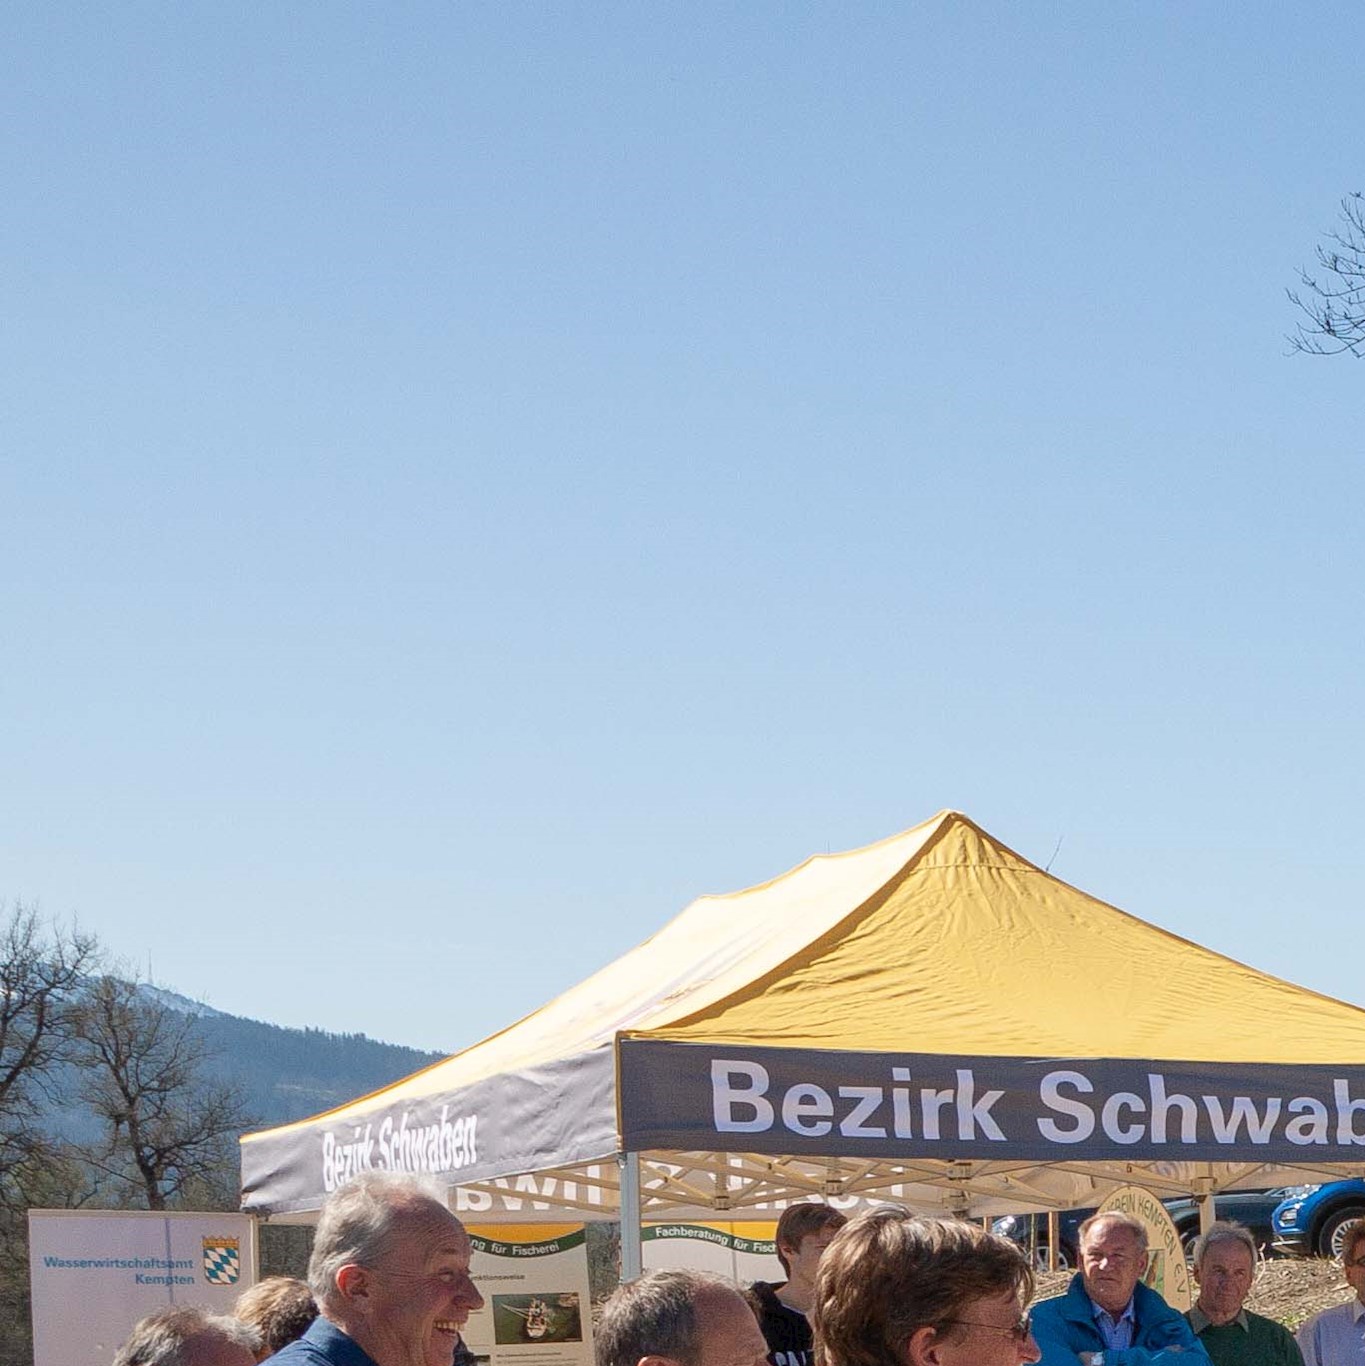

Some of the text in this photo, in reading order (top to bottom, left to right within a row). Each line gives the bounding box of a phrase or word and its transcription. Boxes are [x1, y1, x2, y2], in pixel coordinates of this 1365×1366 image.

[710, 1059, 1007, 1142] Bezirk
[322, 1122, 375, 1192] Bezirk
[378, 1105, 477, 1173] Schwaben
[655, 1227, 729, 1246] Fachberatung
[733, 1238, 749, 1250] für
[490, 1242, 507, 1254] für
[512, 1241, 560, 1256] Fischerei
[43, 1256, 194, 1269] Wasserwirtschaftsamt
[135, 1273, 195, 1286] Kempten
